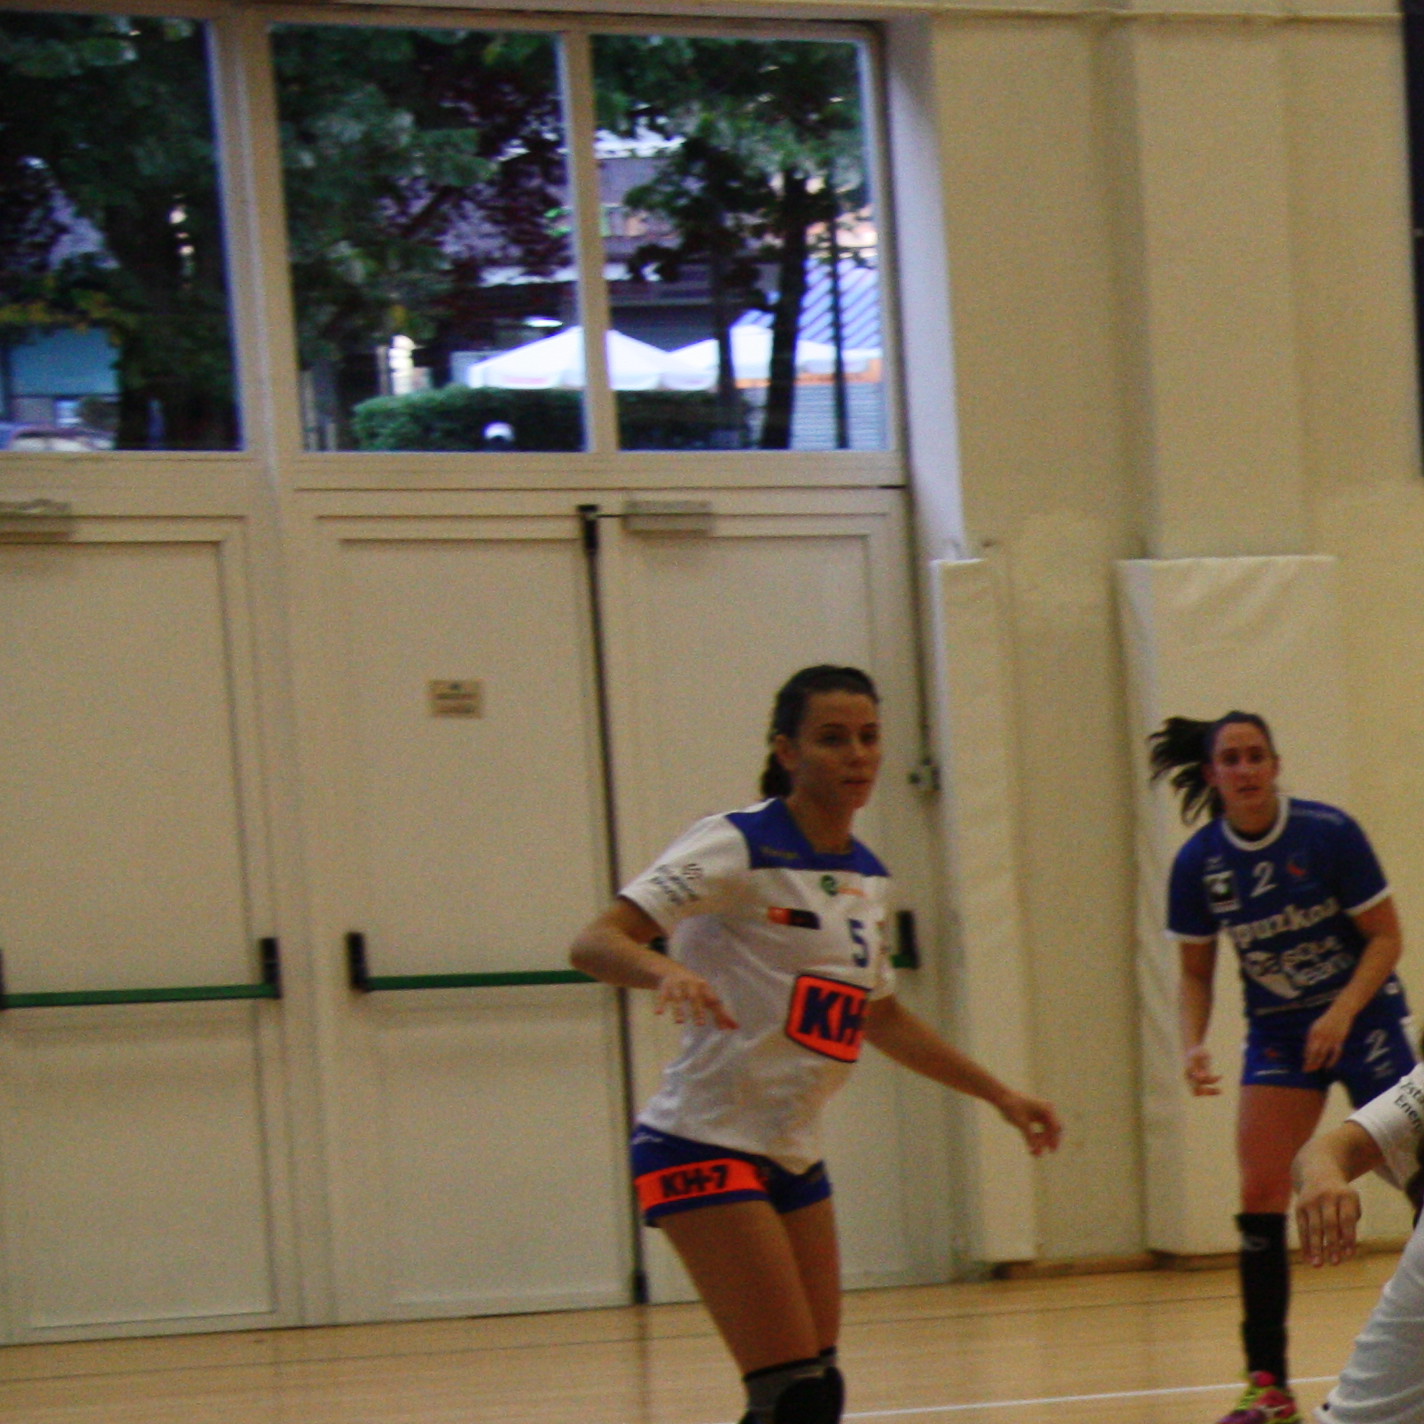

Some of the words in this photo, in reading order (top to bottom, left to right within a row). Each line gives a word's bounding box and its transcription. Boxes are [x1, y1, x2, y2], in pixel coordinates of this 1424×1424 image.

[1251, 861, 1278, 898] 2
[848, 918, 869, 968] 5
[798, 985, 866, 1046] KH
[660, 1164, 729, 1199] KH-7
